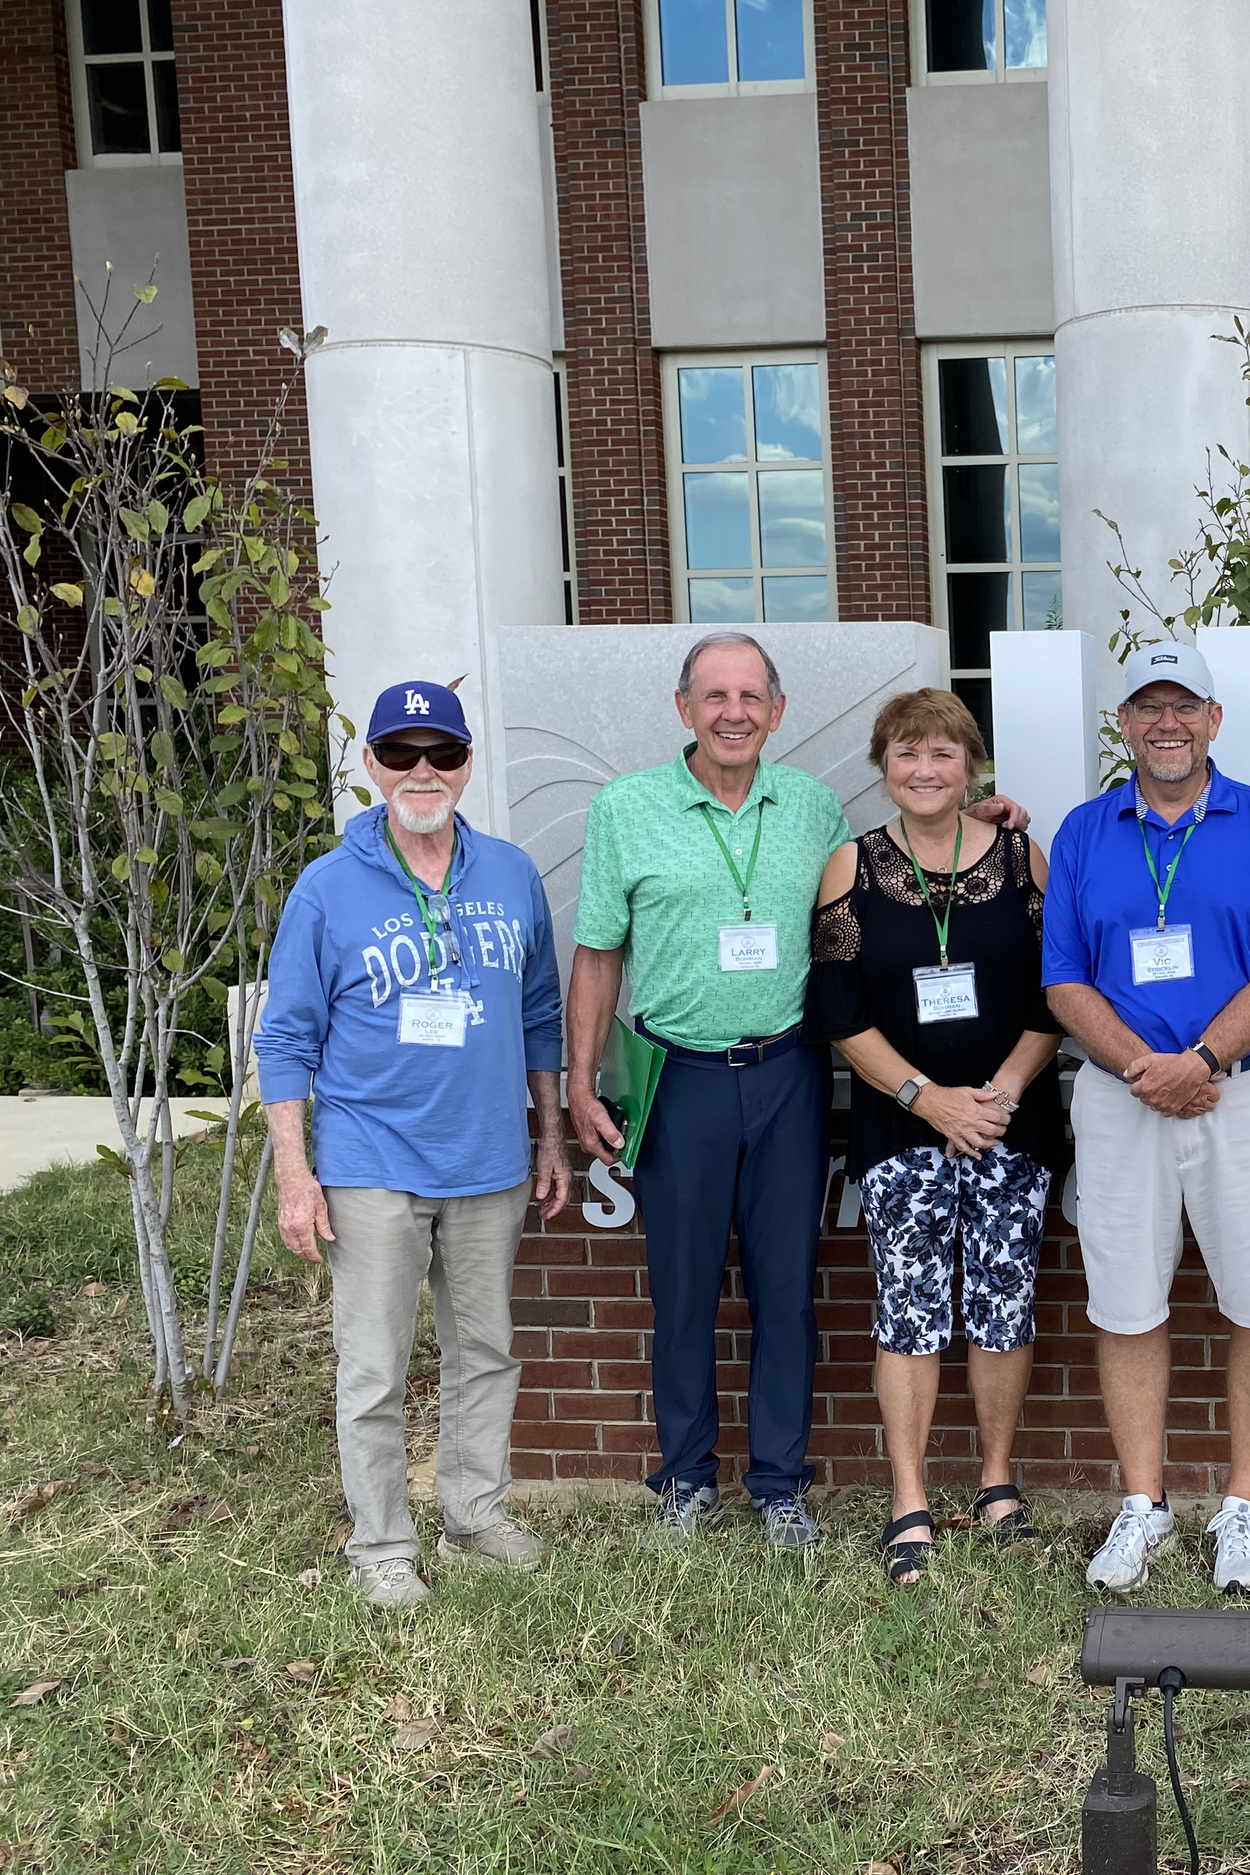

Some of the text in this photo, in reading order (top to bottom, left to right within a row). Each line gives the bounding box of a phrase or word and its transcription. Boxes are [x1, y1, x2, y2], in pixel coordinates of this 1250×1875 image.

[404, 689, 430, 715] LA
[371, 912, 414, 940] LOS
[731, 948, 766, 957] LARRY
[361, 918, 525, 1008] DODERS
[921, 995, 971, 1007] THERESA
[412, 1019, 453, 1030] ROGER
